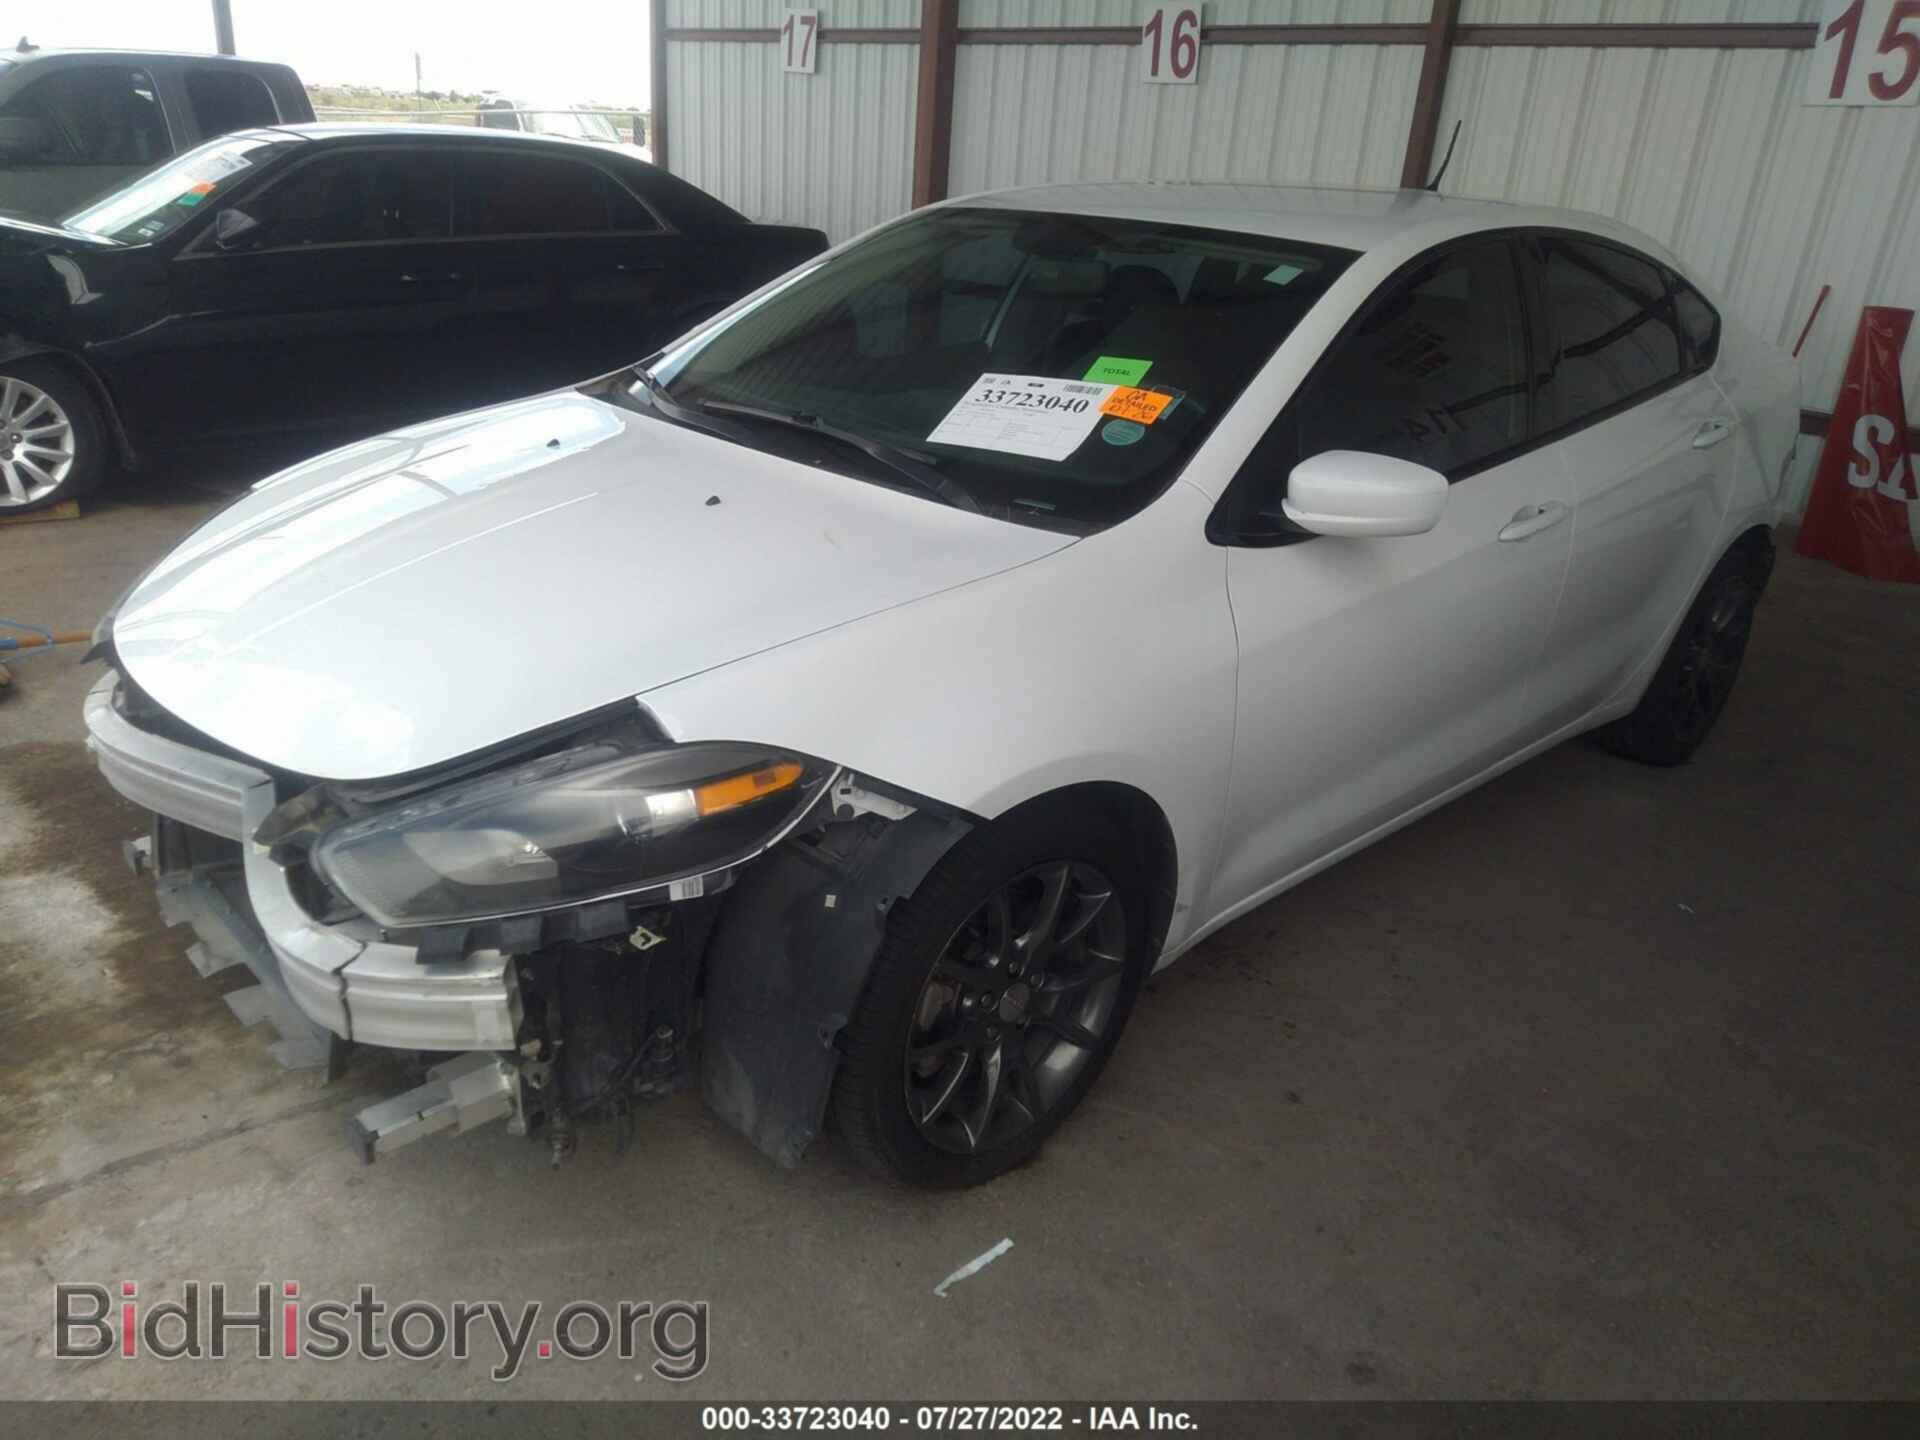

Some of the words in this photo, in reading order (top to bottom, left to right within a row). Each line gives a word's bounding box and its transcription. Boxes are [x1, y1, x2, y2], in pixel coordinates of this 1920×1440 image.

[784, 14, 816, 67] 17
[1145, 9, 1197, 78] 16
[1824, 0, 1920, 101] 15
[1103, 366, 1132, 377] TOTAL
[974, 388, 1091, 414] 33723040
